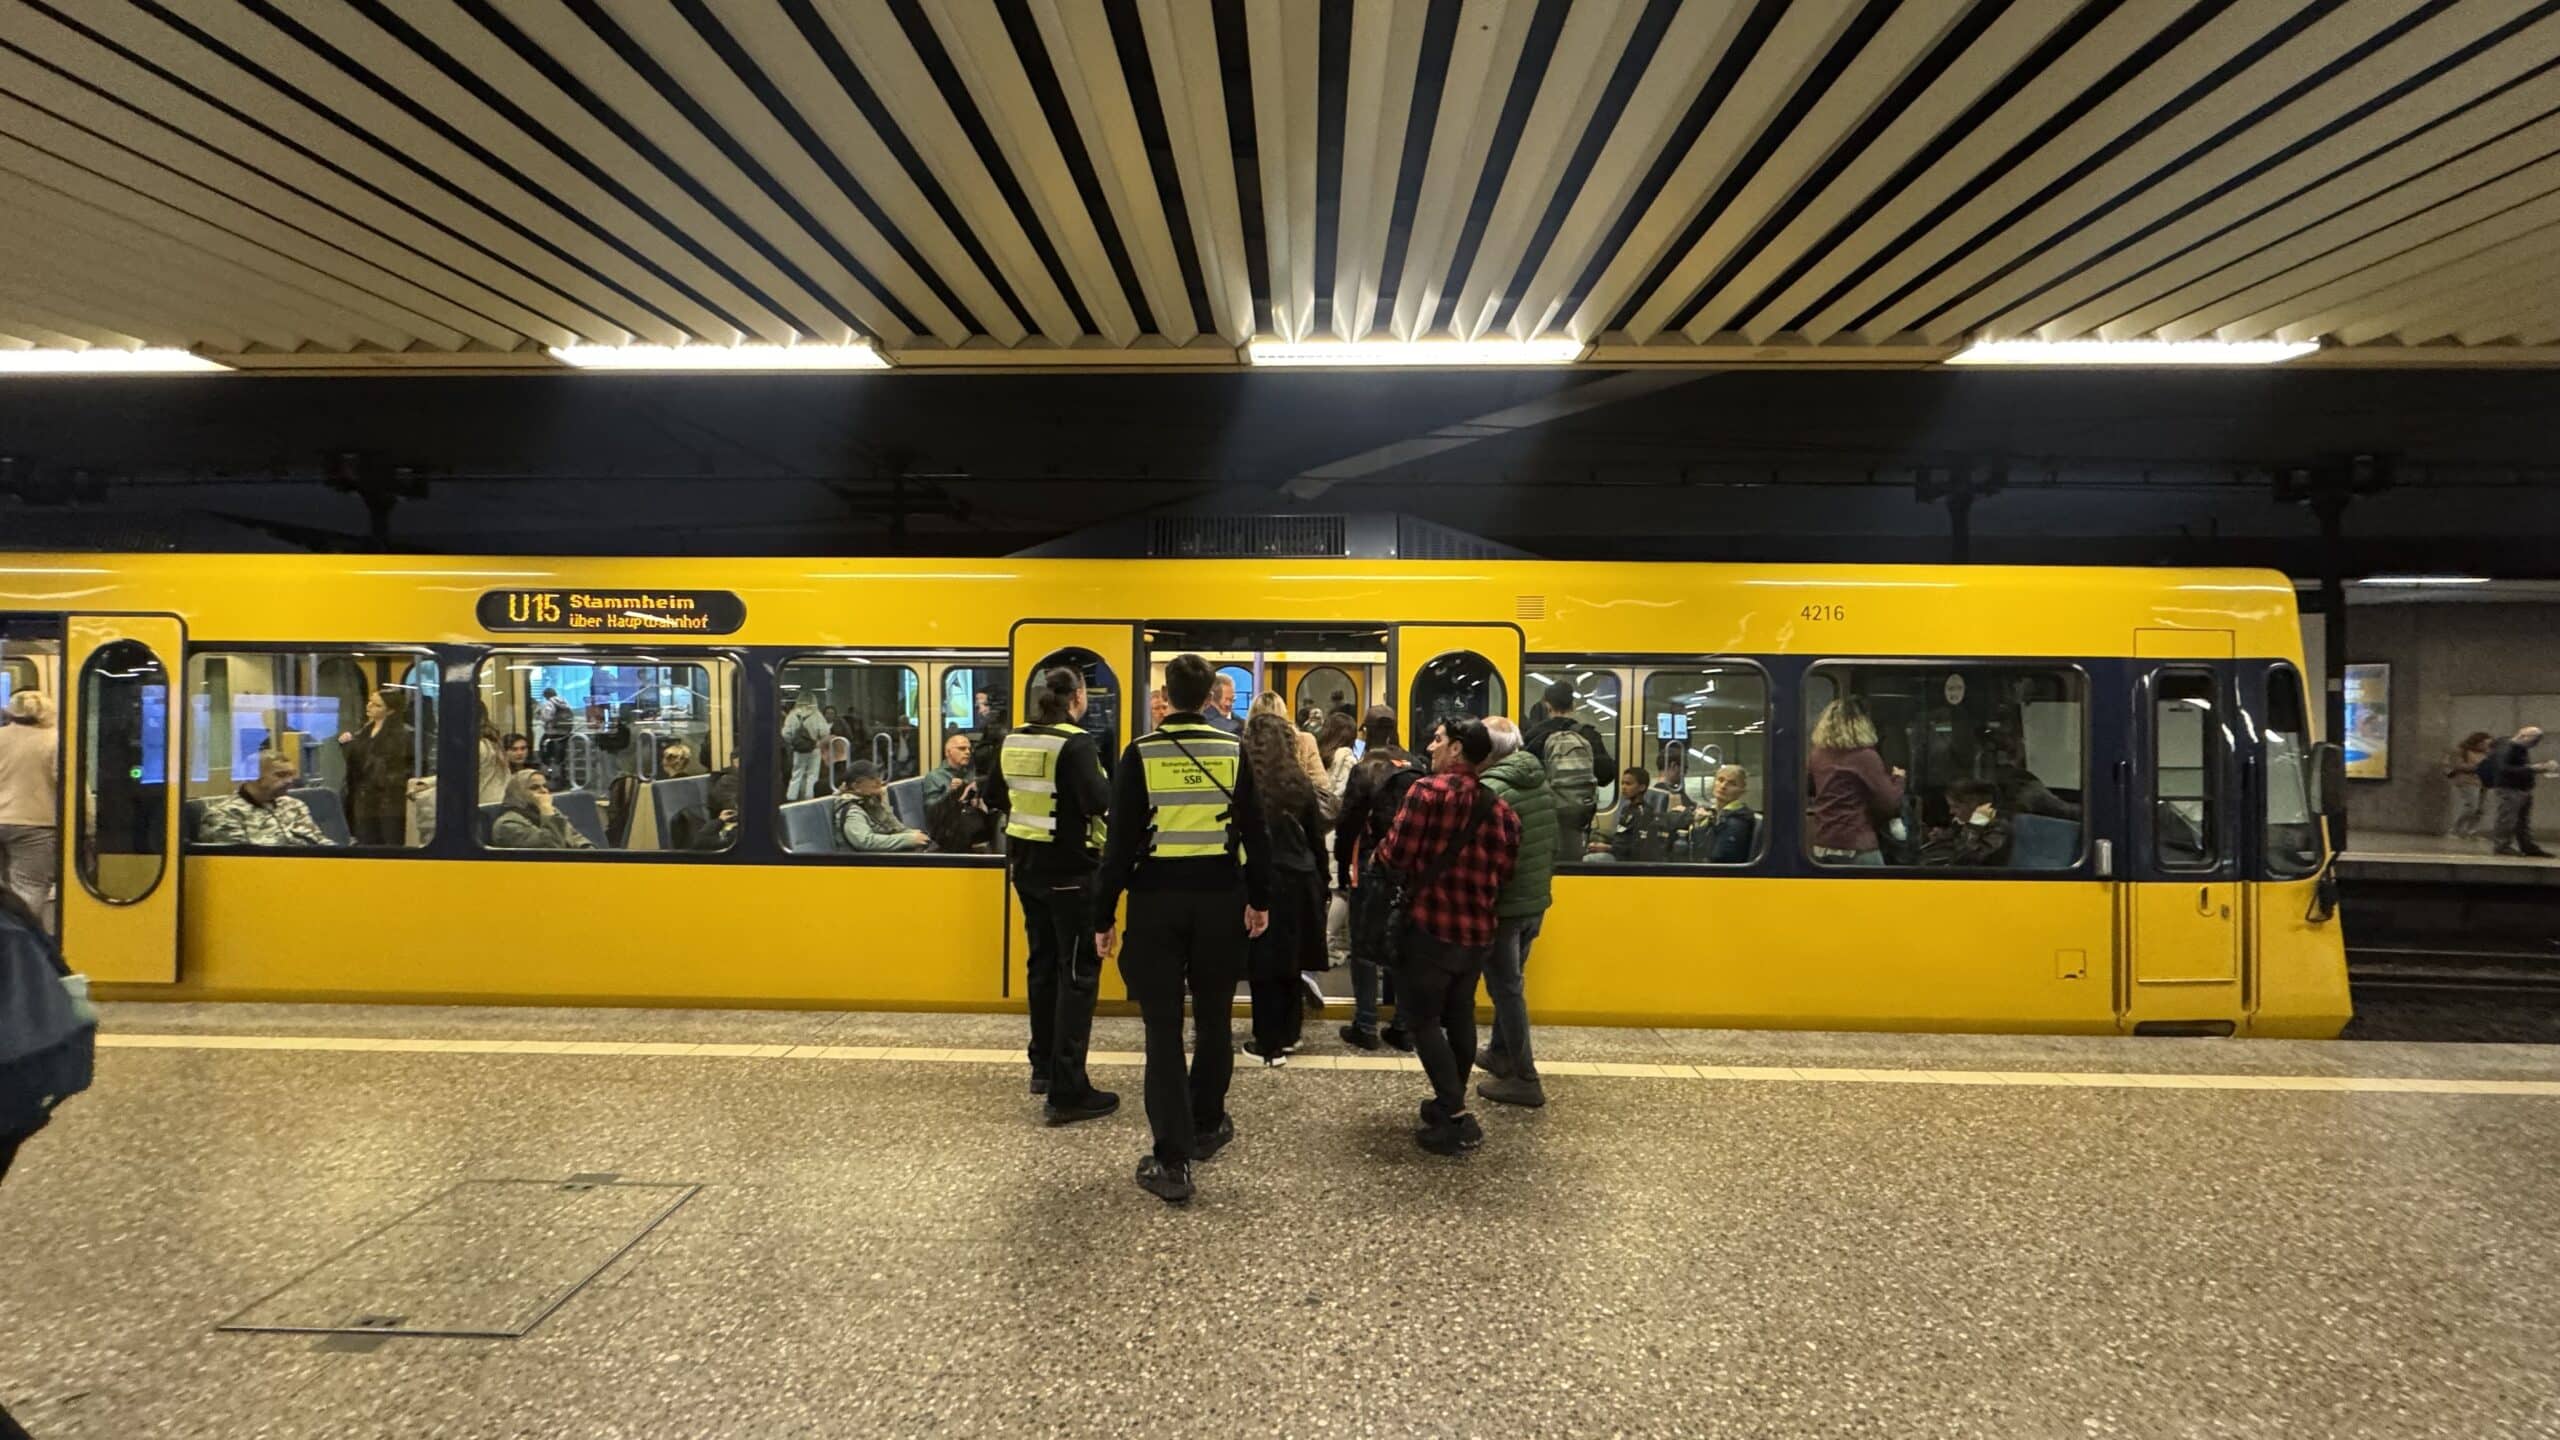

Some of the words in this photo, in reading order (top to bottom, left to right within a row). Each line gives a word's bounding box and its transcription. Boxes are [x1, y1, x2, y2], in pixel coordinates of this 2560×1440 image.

[509, 593, 560, 622] U15
[569, 594, 695, 609] Stammheim
[569, 613, 602, 628] über
[1801, 605, 1844, 621] 4216
[1184, 775, 1202, 784] SSB
